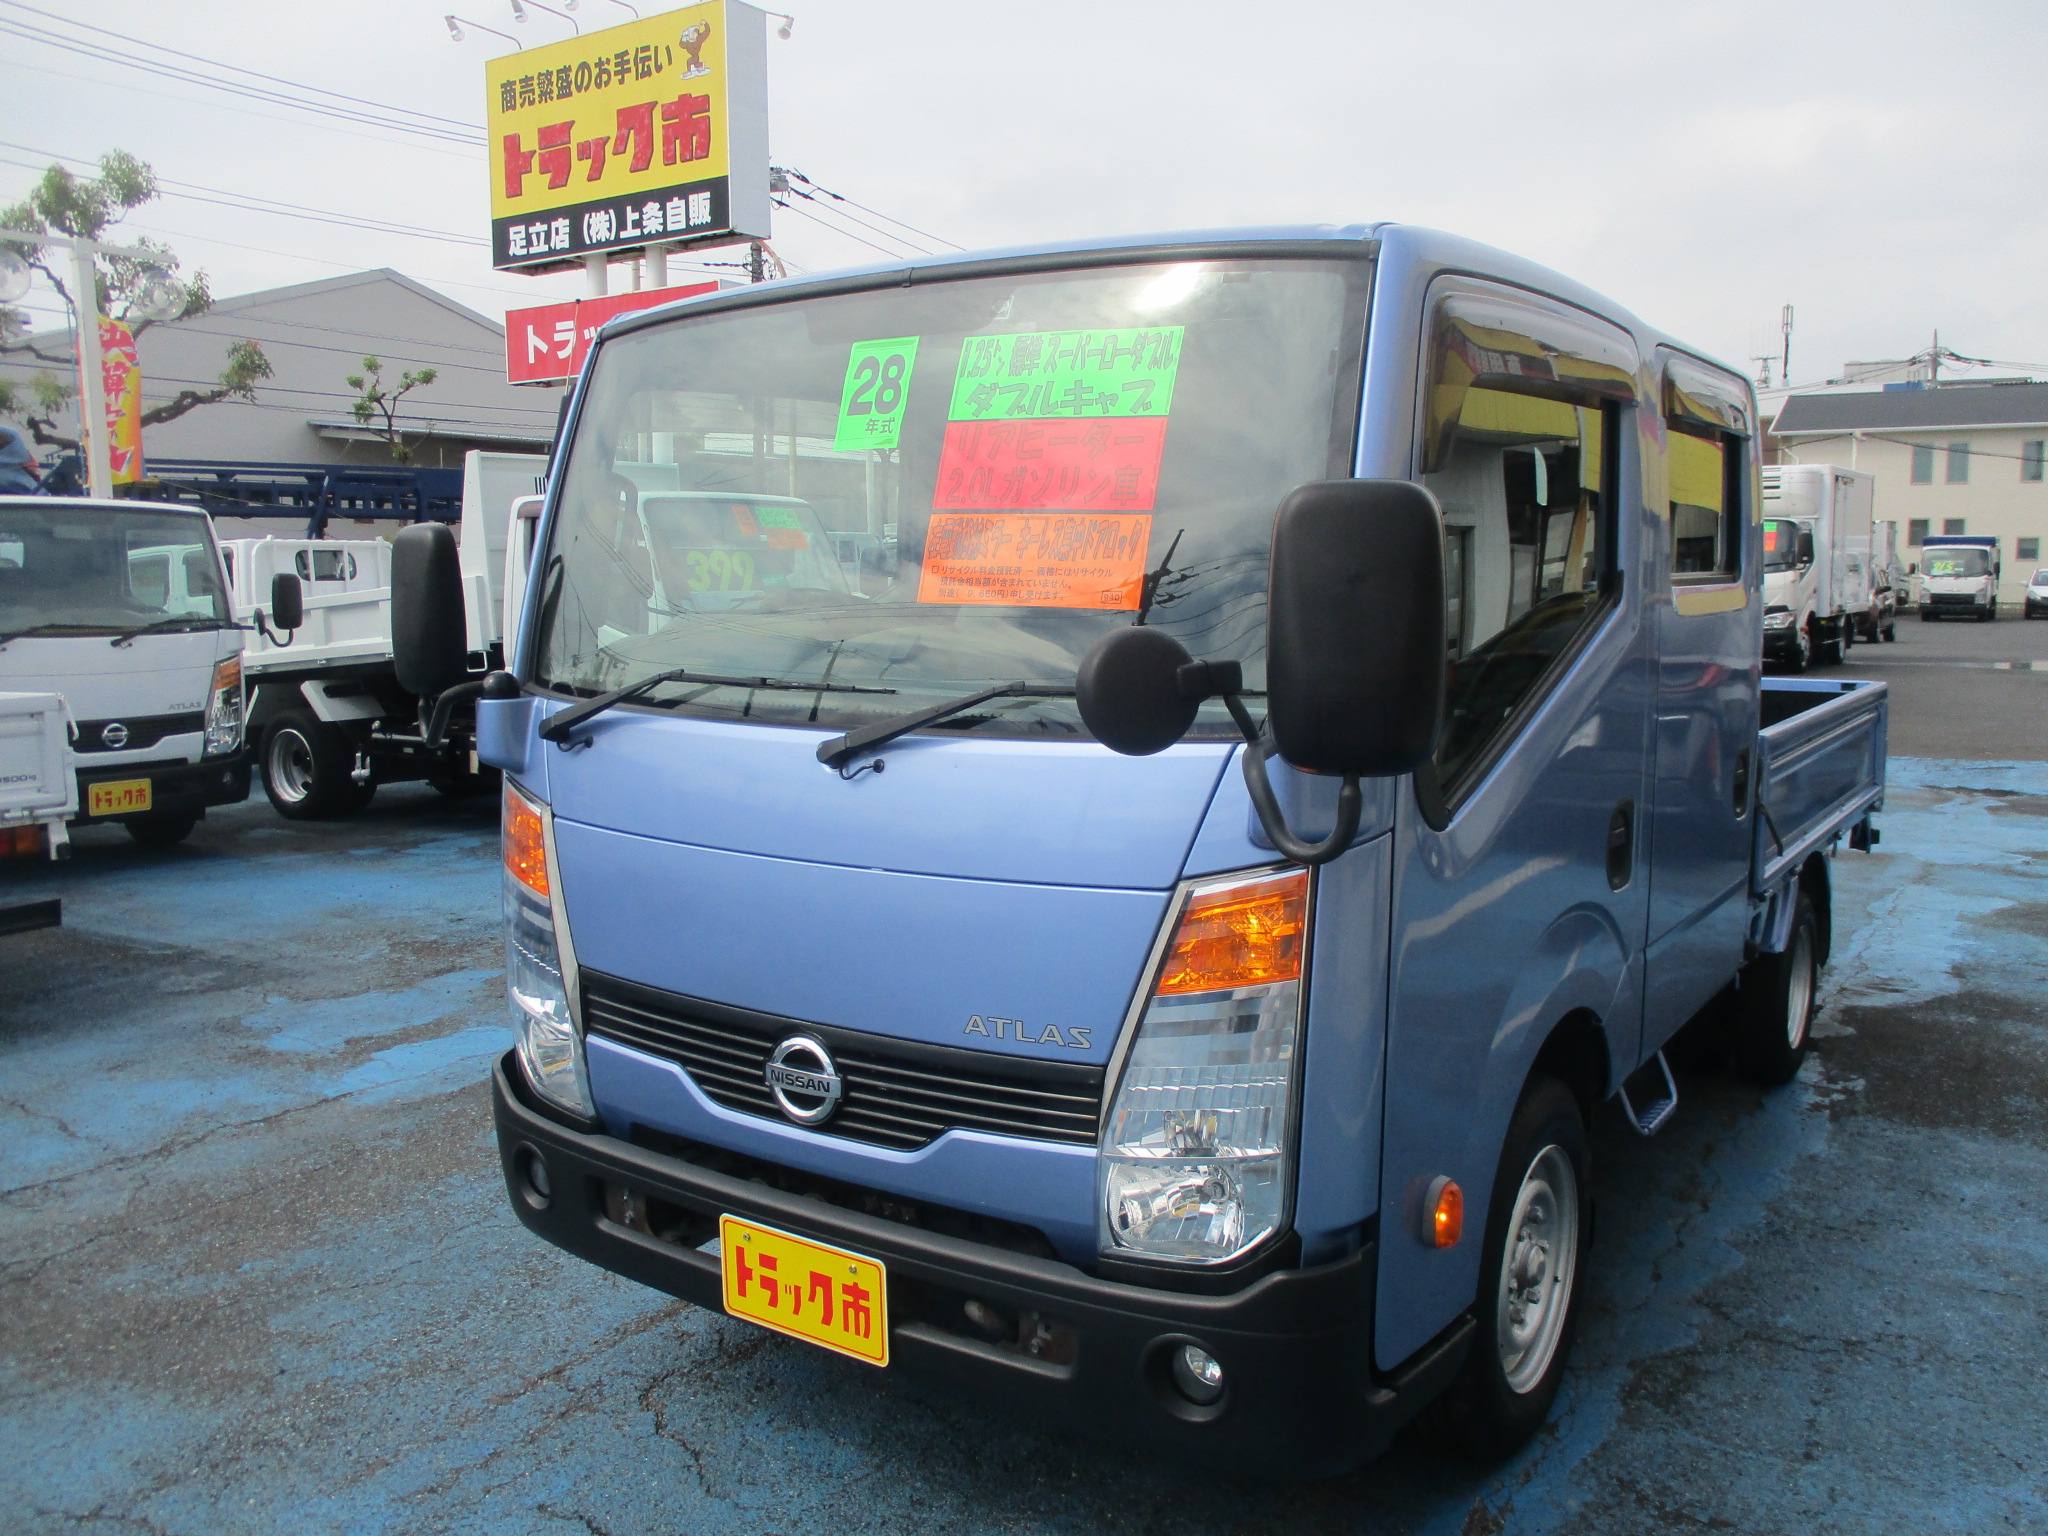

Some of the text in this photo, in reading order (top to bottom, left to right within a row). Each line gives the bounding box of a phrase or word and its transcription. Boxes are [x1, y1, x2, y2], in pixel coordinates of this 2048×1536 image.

[500, 44, 673, 113] 商売繁盛のお手伝い
[503, 92, 711, 199] トラック市
[508, 191, 712, 257] 足立店 (株)上条自販
[847, 353, 906, 417] 28
[965, 379, 1156, 418] ダブルキャブ
[865, 418, 896, 435] 年式
[957, 422, 1145, 461] リアヒーター
[946, 465, 1143, 506] 2.0Lガソリン車
[685, 551, 755, 591] 399
[95, 788, 146, 809] トラック市
[963, 1015, 1093, 1050] ATLAS
[770, 1069, 831, 1094] NISSAN
[735, 1246, 871, 1340] トラック市
